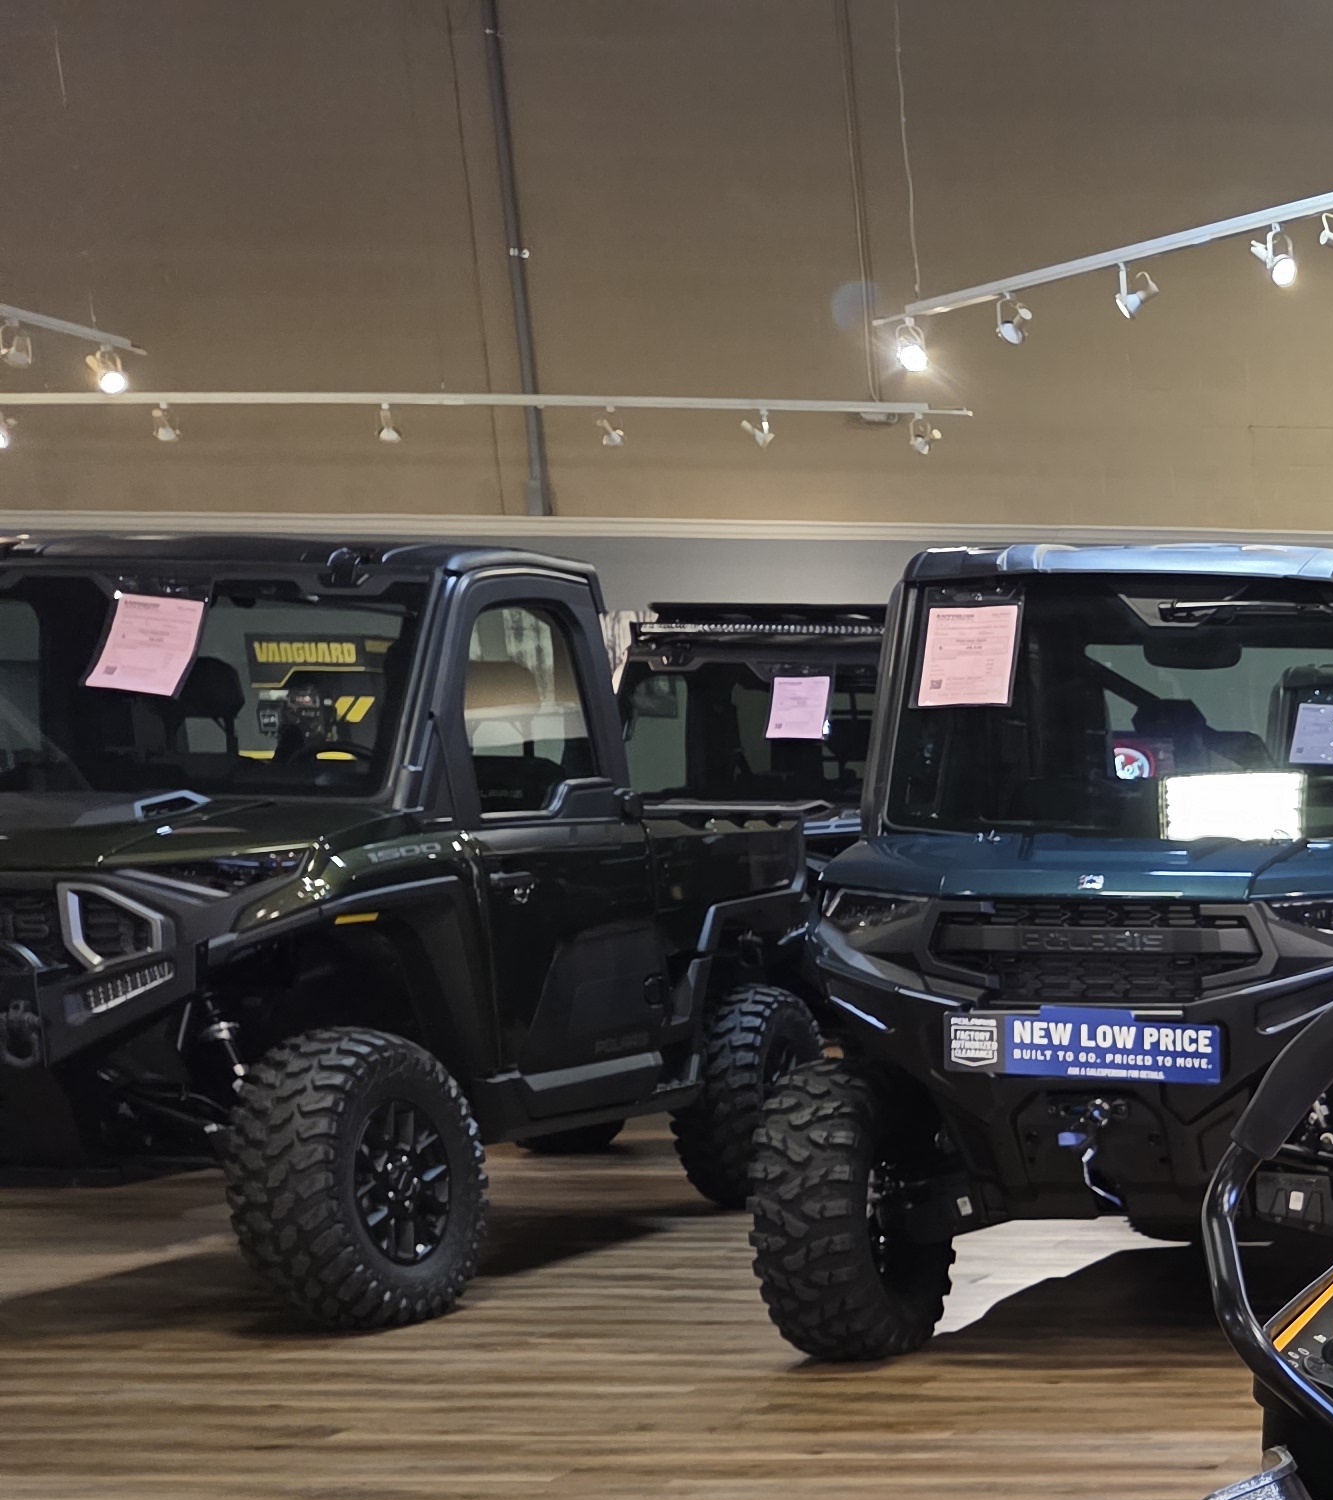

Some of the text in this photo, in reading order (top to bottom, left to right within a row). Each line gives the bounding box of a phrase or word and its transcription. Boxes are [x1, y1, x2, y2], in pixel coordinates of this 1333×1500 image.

[254, 641, 356, 663] VANGUARD
[956, 1030, 990, 1041] FACTORY
[1013, 1020, 1213, 1053] NEW LOW PRICE
[1013, 1048, 1213, 1069] BUILT TO GO. PRICED TO MOVE.
